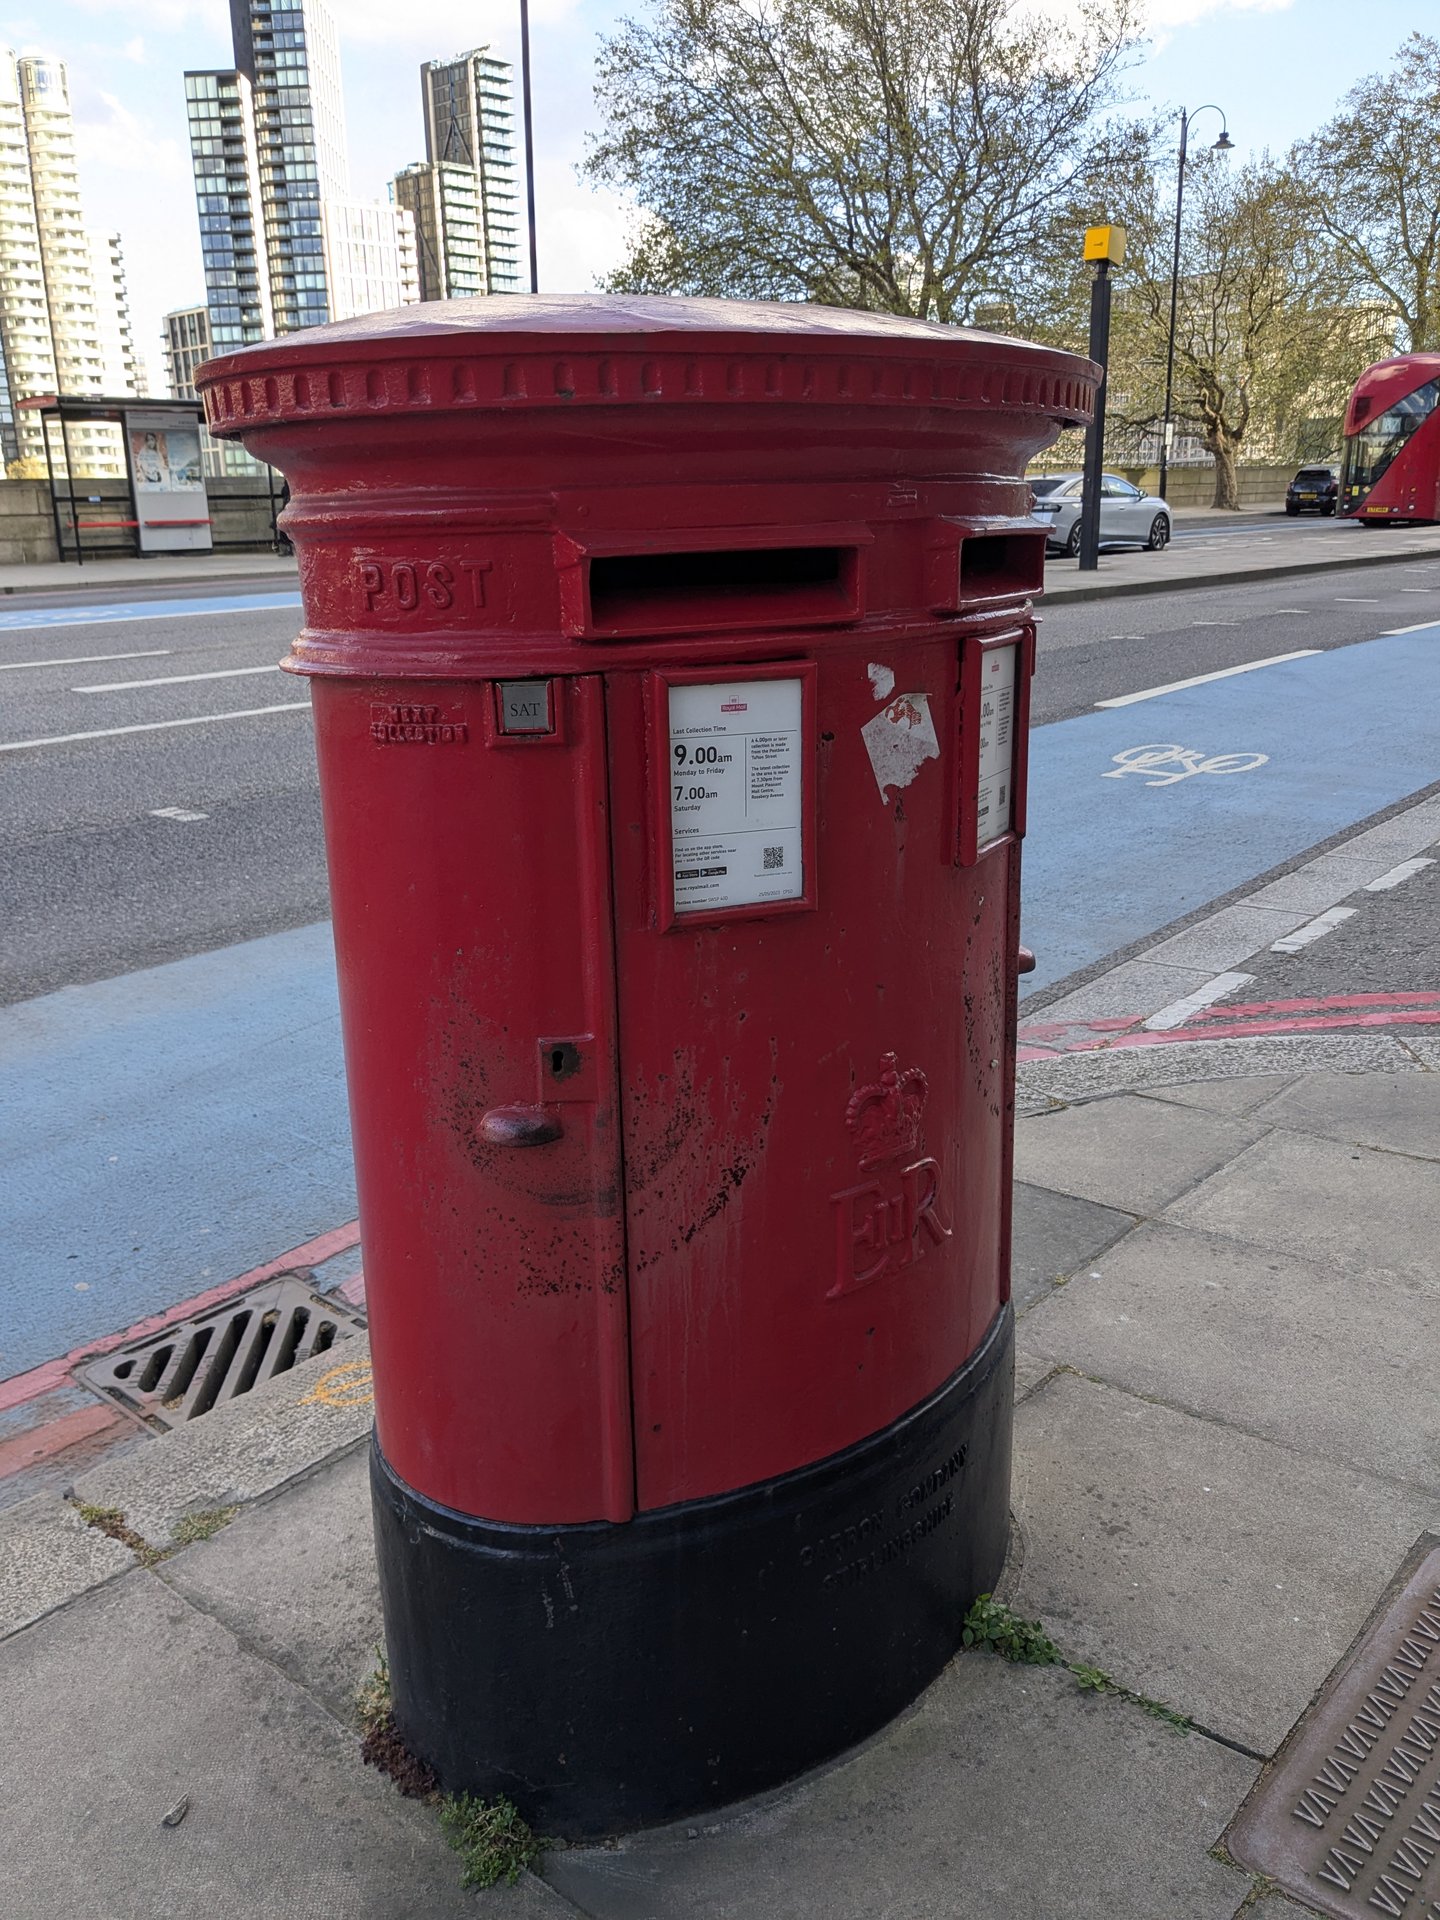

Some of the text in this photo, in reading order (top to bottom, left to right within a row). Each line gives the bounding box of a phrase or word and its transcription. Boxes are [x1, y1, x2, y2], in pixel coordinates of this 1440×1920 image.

[359, 560, 493, 611] POST
[386, 703, 440, 724] NEXT
[510, 702, 541, 717] SAT
[370, 723, 468, 745] COLLECTION
[674, 744, 732, 766] 9.00am
[673, 769, 696, 777] Monday
[706, 767, 724, 775] Friday
[674, 786, 718, 802] 7.00am
[674, 804, 701, 813] Saturday
[674, 827, 699, 835] Services
[675, 882, 719, 892] www.royalmail.com
